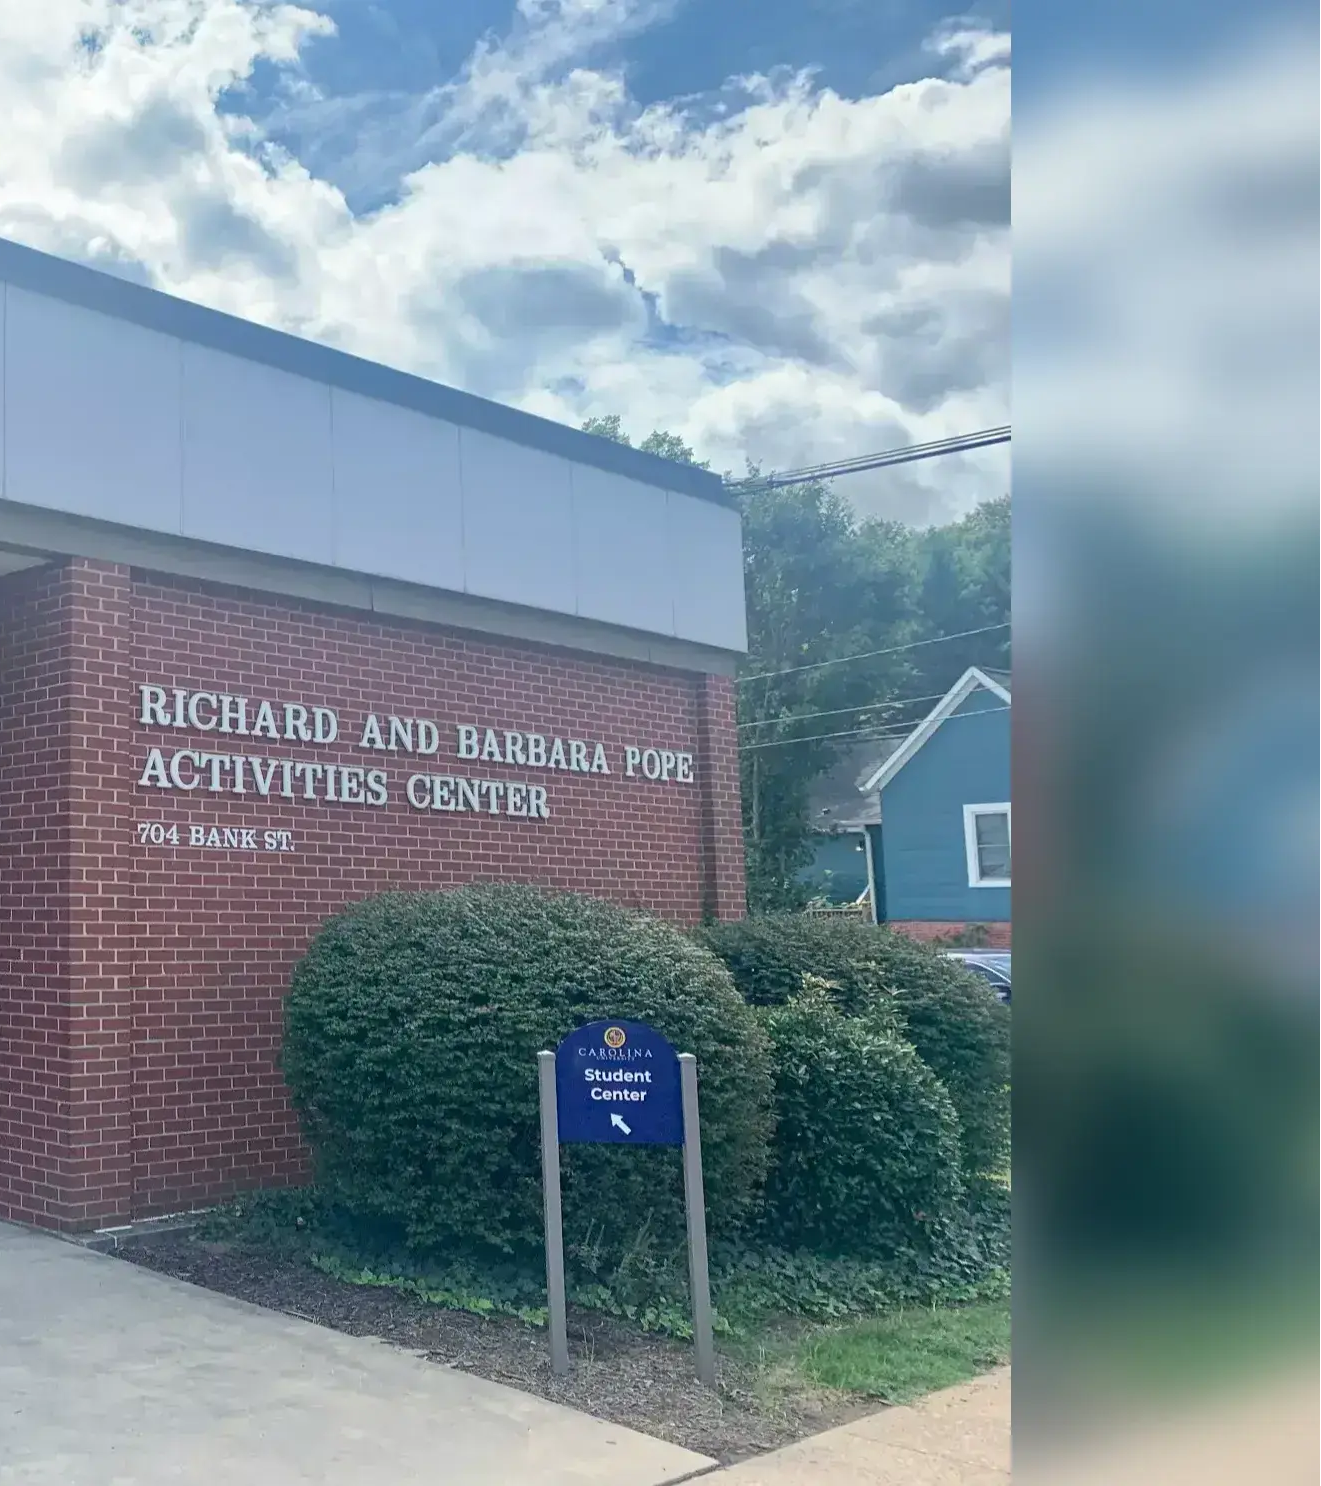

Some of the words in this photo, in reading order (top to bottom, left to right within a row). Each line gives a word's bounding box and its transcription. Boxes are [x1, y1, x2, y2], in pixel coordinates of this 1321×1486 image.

[139, 685, 338, 743] RICHARD
[359, 714, 439, 754] AND
[456, 725, 611, 775] BARBARA
[624, 745, 694, 783] POPE
[138, 748, 387, 805] ACTIVITIES
[406, 773, 550, 818] CENTER
[138, 824, 179, 845] 704
[189, 826, 258, 849] BANK
[264, 830, 295, 852] ST.
[579, 1048, 653, 1058] CAROLINA
[584, 1068, 652, 1083] Student
[591, 1087, 647, 1102] Center
